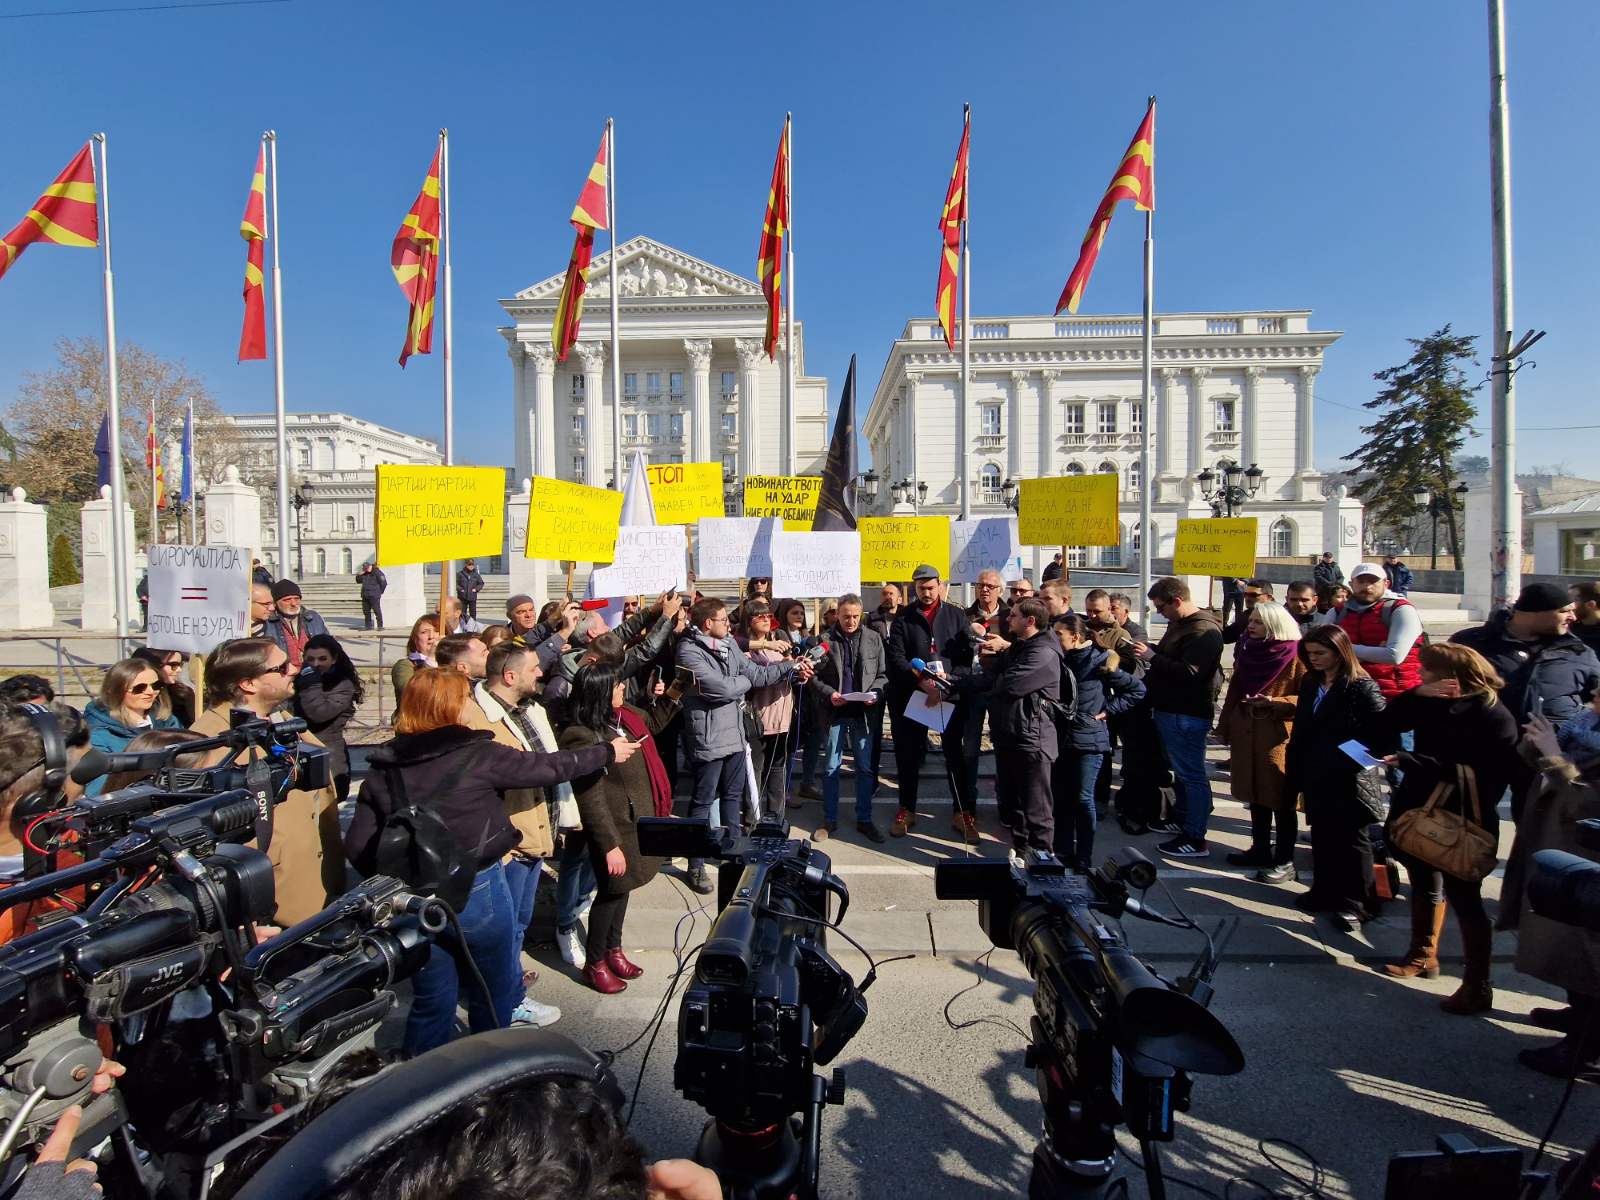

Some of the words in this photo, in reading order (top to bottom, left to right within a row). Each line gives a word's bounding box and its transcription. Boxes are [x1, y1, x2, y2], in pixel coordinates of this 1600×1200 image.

[782, 492, 810, 505] УДАР
[150, 546, 242, 570] СИРОМАШТИЈА
[257, 790, 269, 821] SONY
[150, 961, 185, 984] JVC
